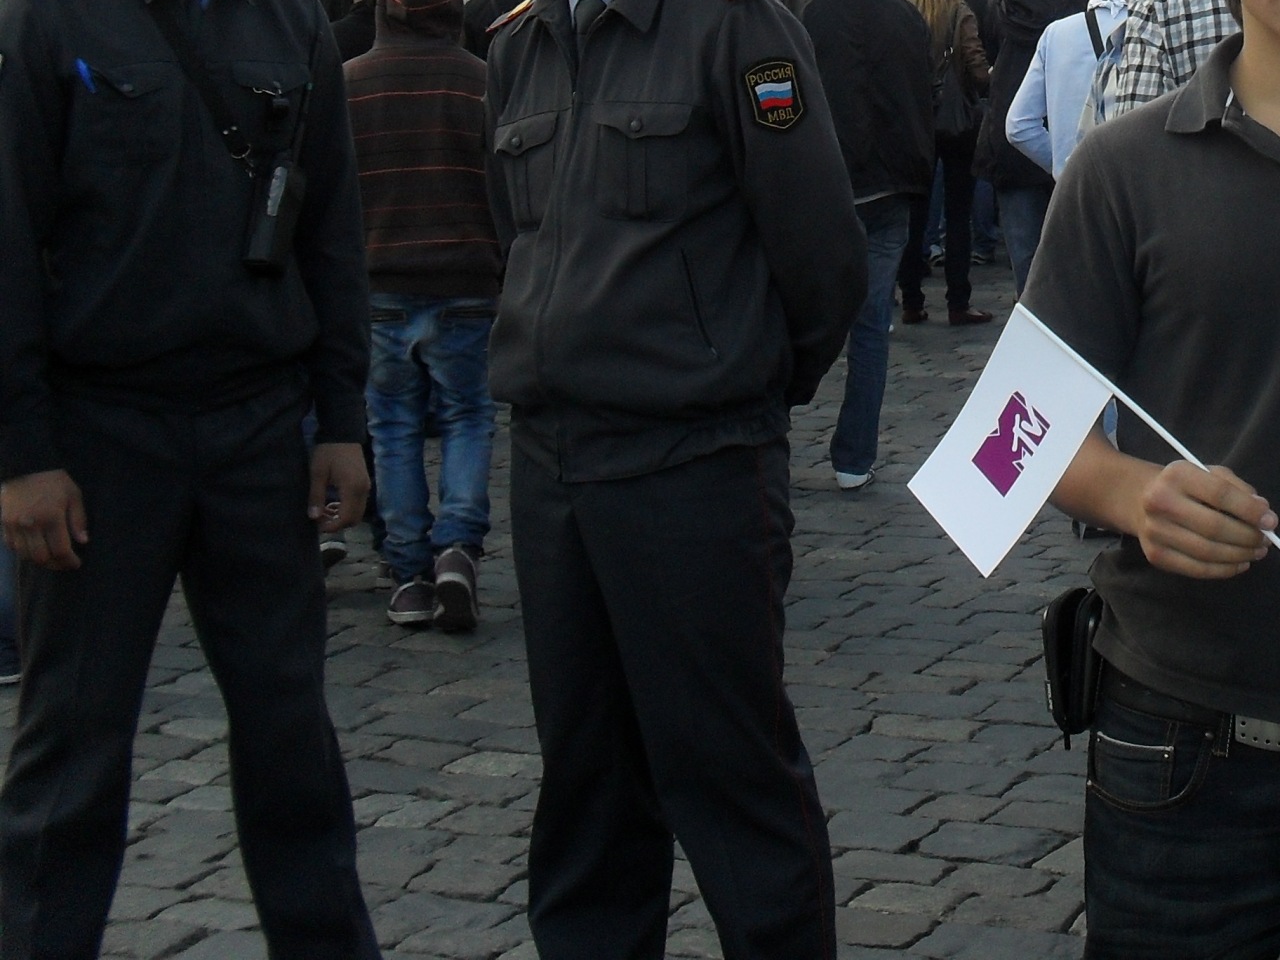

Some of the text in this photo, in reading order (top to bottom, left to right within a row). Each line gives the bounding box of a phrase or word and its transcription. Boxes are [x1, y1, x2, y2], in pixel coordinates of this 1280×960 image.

[749, 66, 792, 86] РОССИЯ
[767, 107, 795, 123] МВД
[971, 390, 1052, 499] MTV
